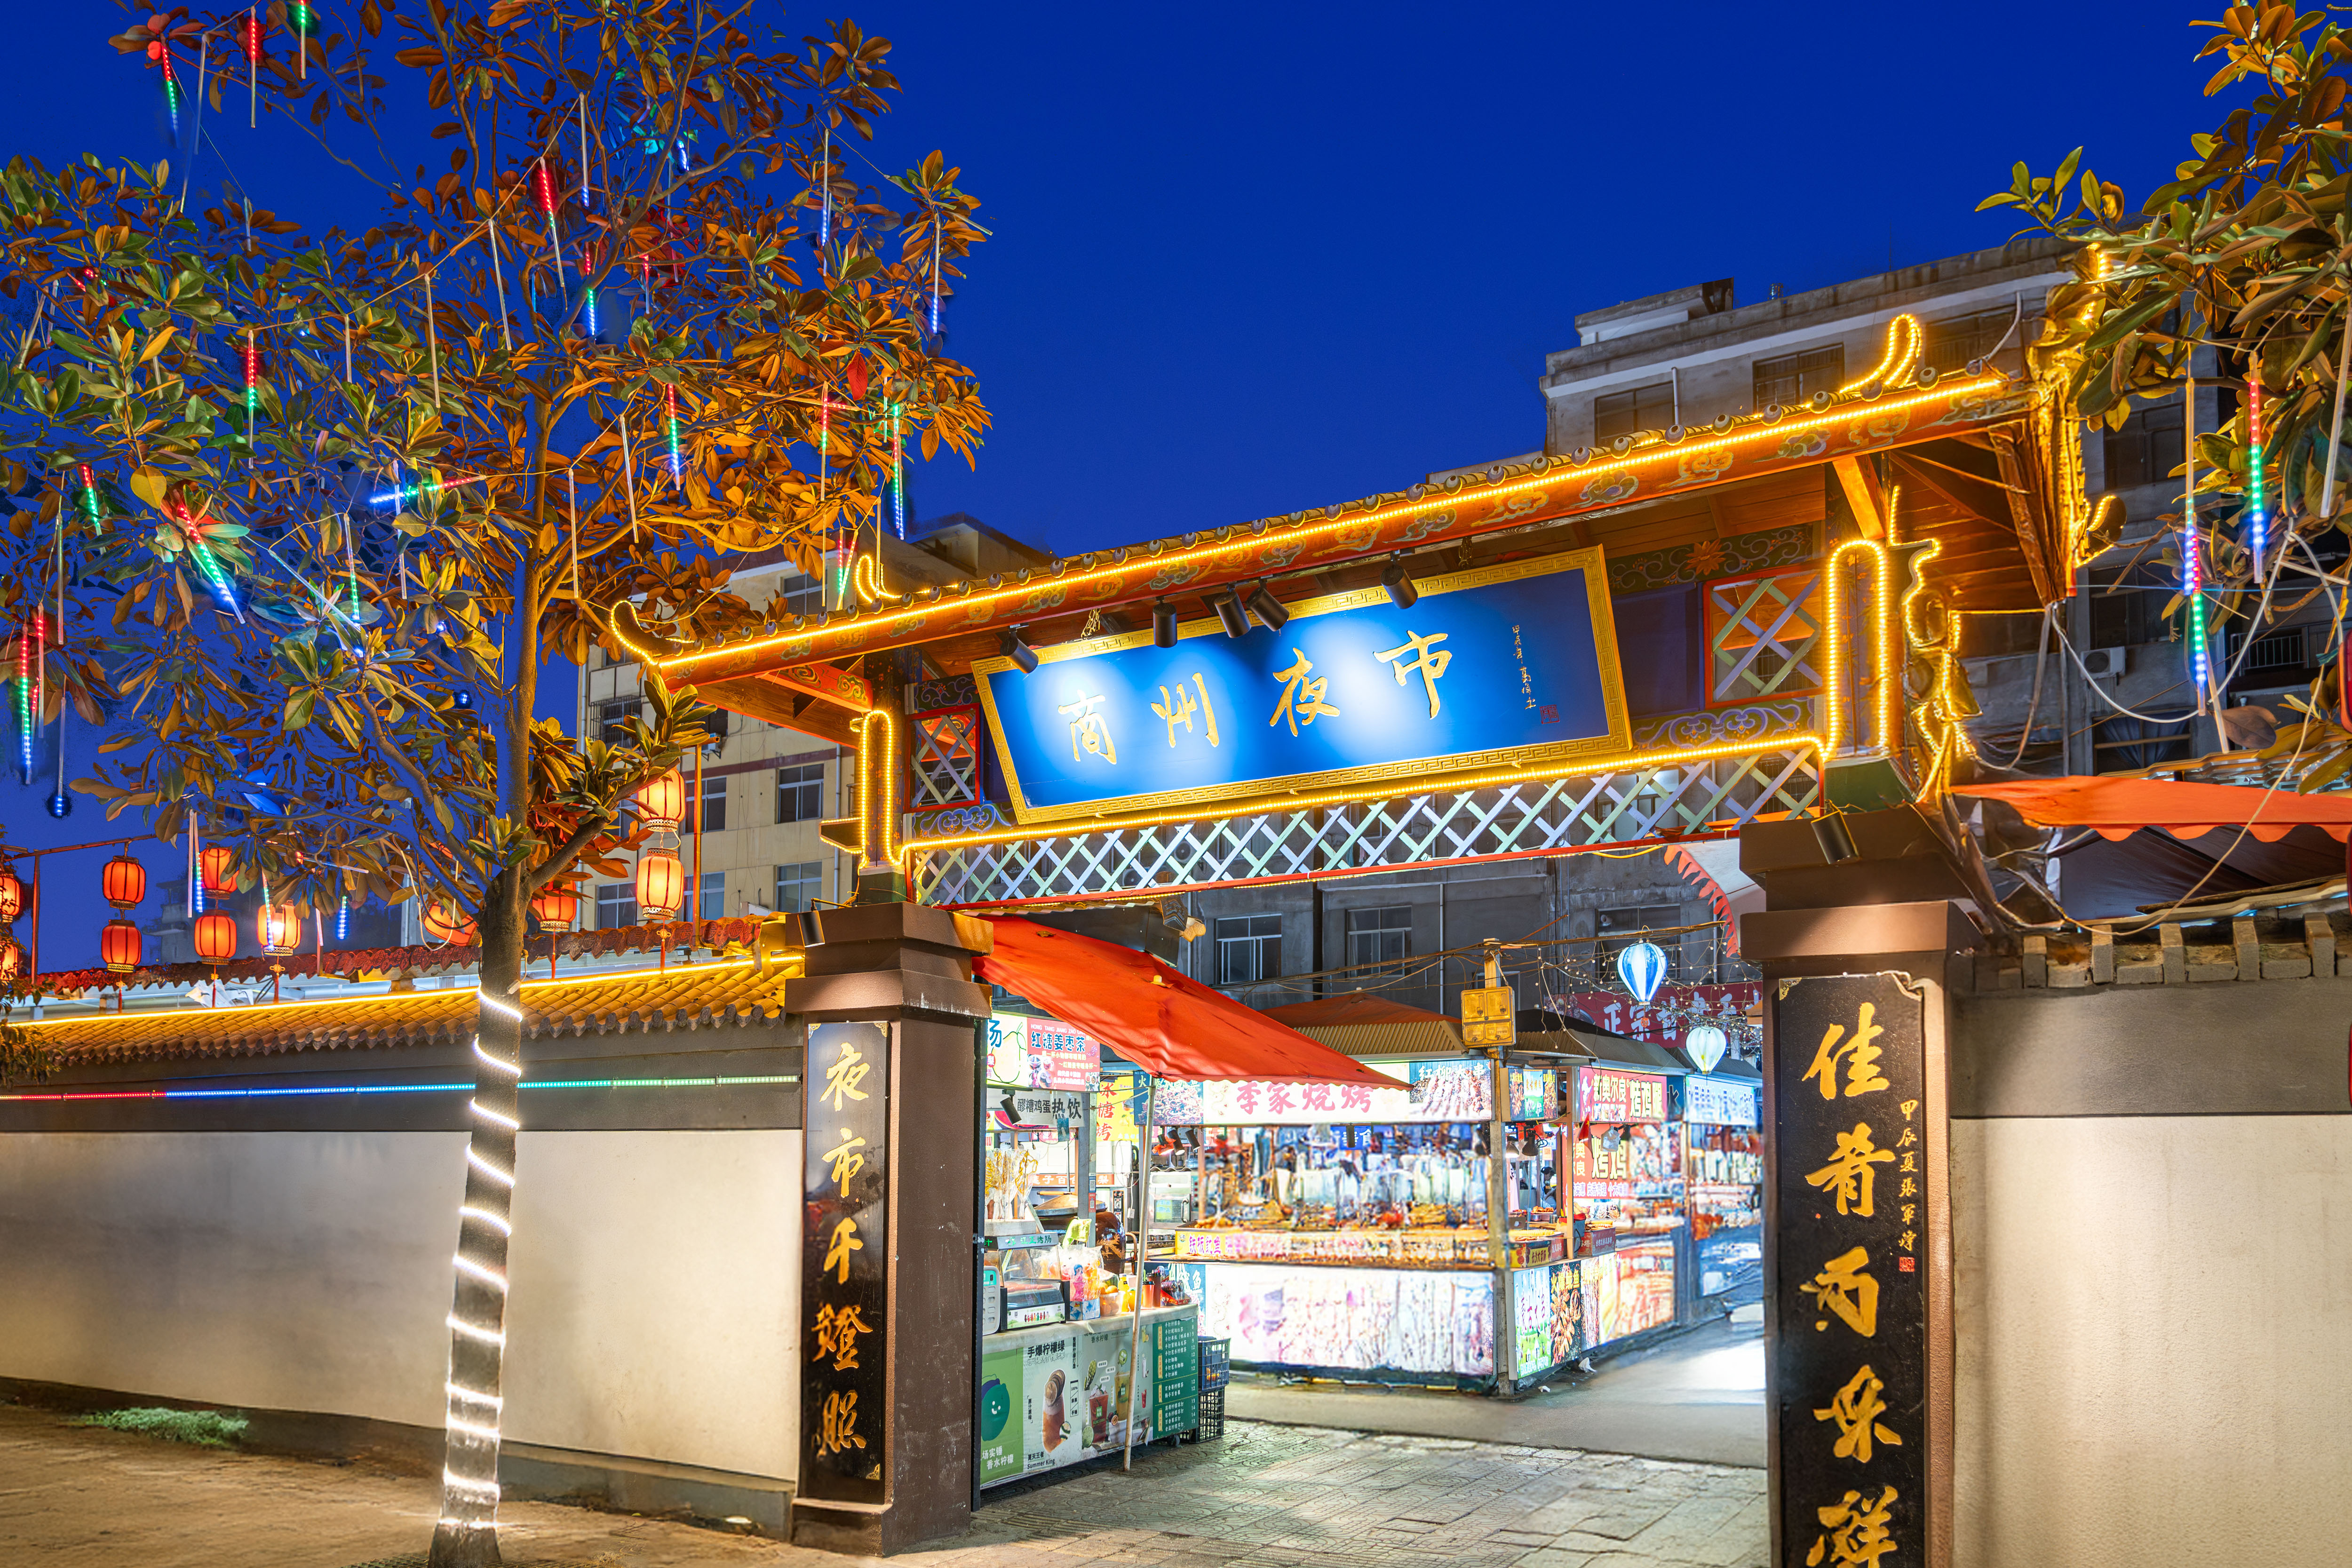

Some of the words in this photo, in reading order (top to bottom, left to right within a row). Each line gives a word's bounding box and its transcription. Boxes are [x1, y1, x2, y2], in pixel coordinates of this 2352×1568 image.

[1058, 629, 1453, 765] 商州夜市
[1031, 1031, 1086, 1053] 红糖姜枣茶
[1418, 1062, 1485, 1082] 红柳大串
[1236, 1081, 1374, 1114] 李家烧烤
[1593, 1074, 1627, 1103] 新奥尔良
[1017, 1098, 1051, 1113] 醪糟鸡蛋
[1052, 1098, 1082, 1119] 热饮
[1027, 1340, 1065, 1358] 手爆柠檬绿
[986, 1454, 1014, 1470] 香水柠檬
[1027, 1451, 1044, 1461] 夏天王者
